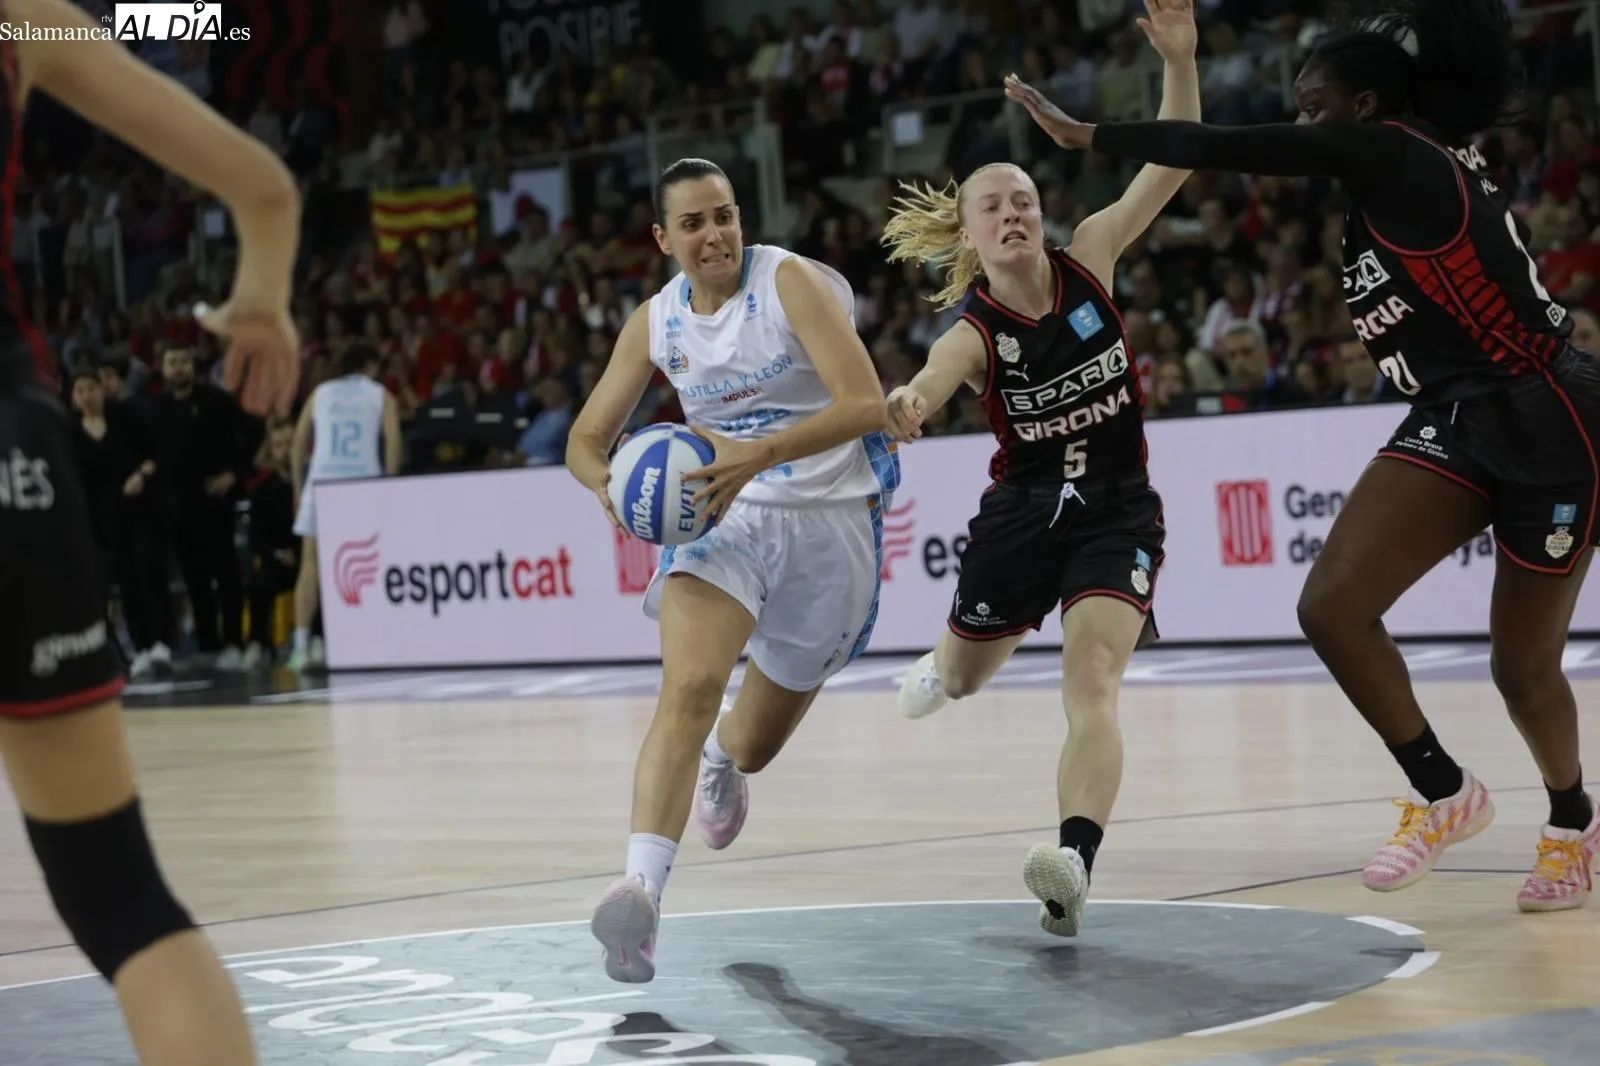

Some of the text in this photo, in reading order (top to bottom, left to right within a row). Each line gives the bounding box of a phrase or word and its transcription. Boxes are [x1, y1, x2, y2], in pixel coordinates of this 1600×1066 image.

[1011, 363, 1102, 411] SPAR
[1013, 384, 1132, 442] GIRONA
[331, 420, 363, 458] 12
[1063, 437, 1088, 480] 5
[631, 466, 662, 540] Wilson
[385, 547, 575, 618] esportcat
